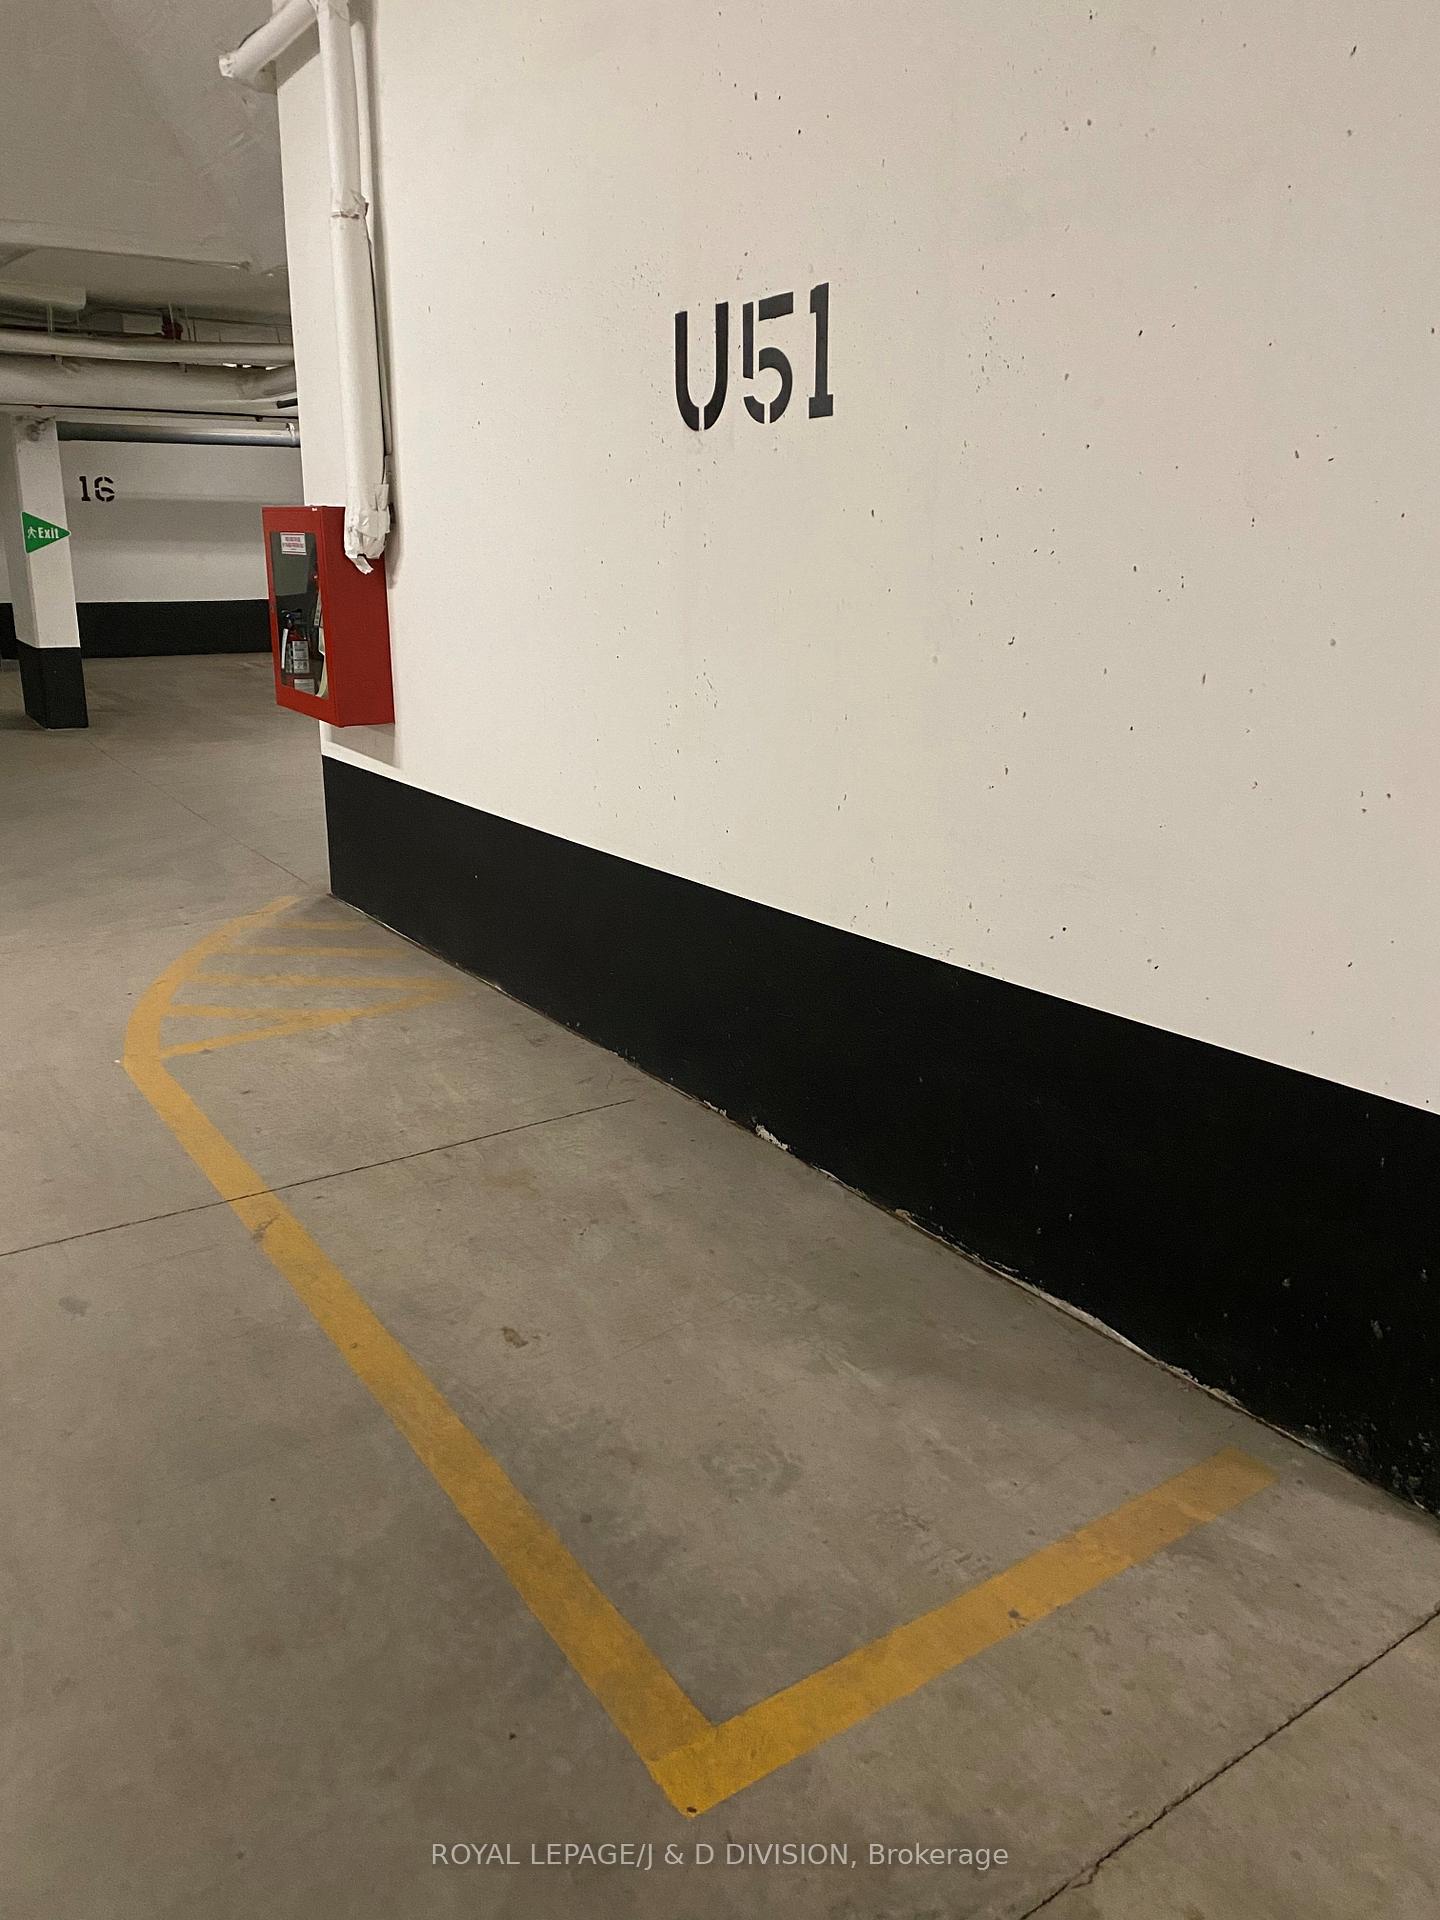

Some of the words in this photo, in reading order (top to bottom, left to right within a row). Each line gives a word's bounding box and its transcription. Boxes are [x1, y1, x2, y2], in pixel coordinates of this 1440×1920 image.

[674, 282, 834, 432] U51
[78, 475, 115, 502] 16
[37, 526, 60, 539] Exit
